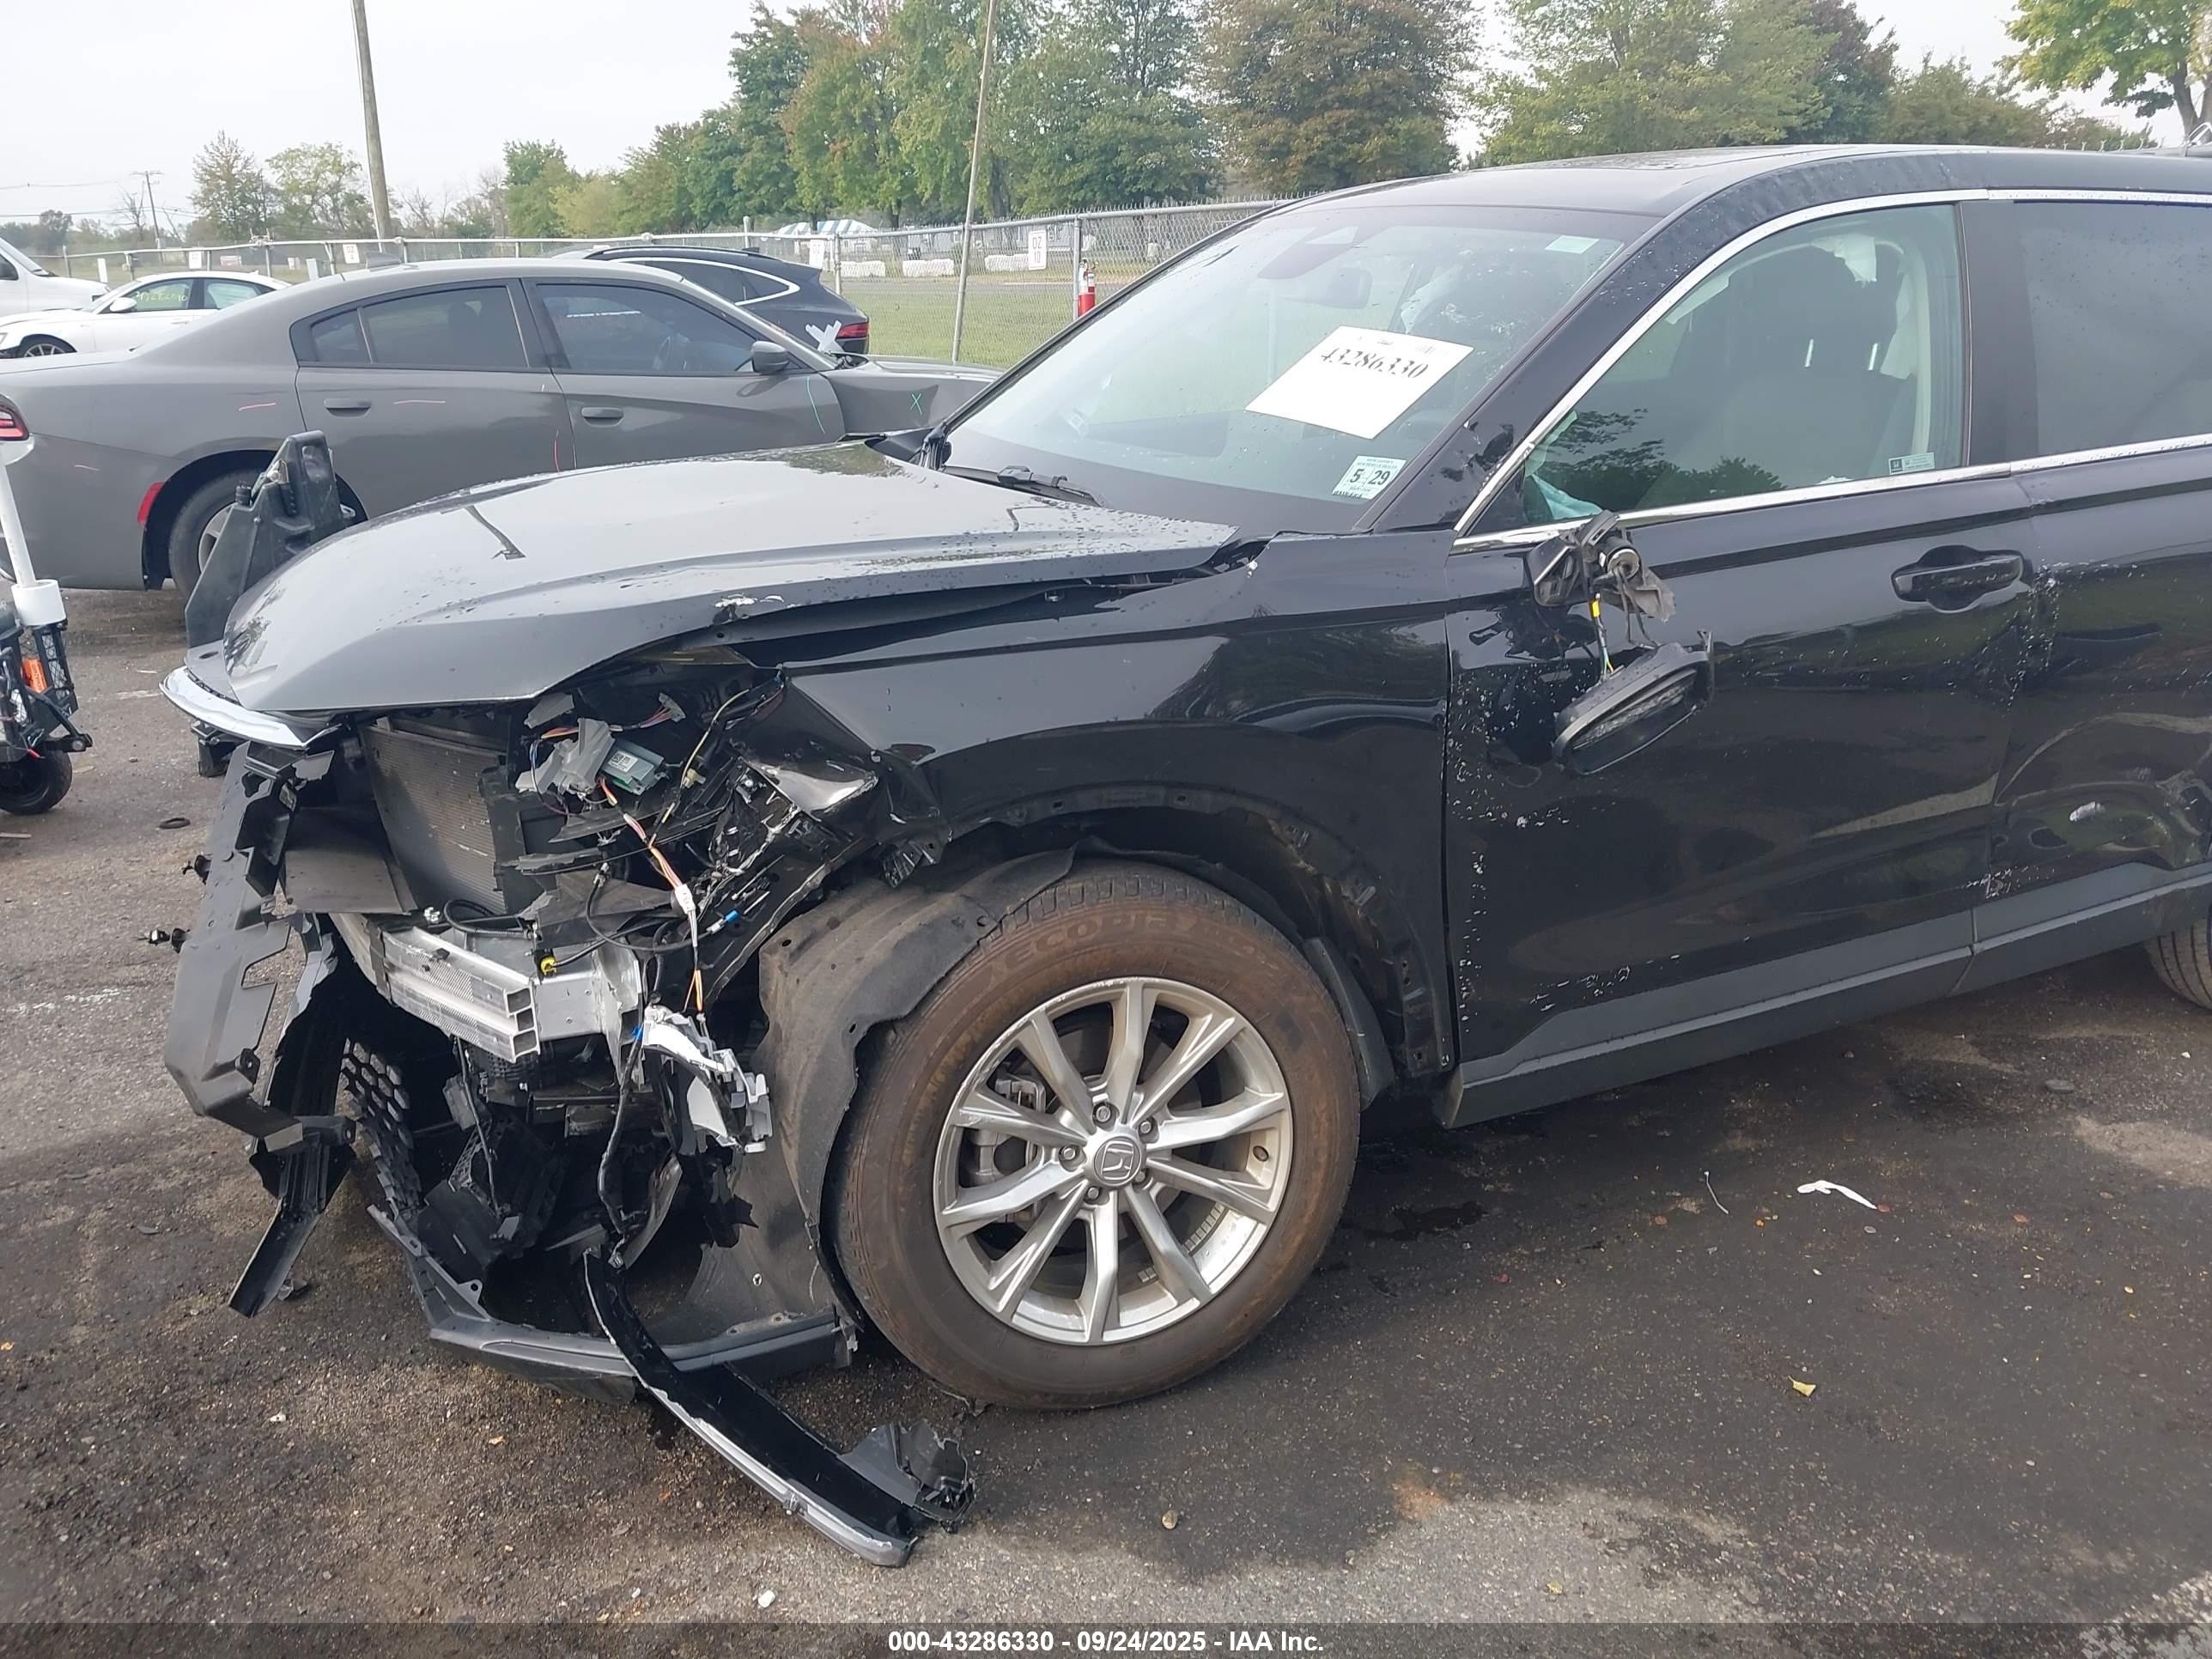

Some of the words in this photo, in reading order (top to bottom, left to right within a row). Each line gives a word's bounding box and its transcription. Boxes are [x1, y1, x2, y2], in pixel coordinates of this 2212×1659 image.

[1321, 347, 1429, 379] 43286330
[1349, 468, 1365, 483] 5
[1367, 470, 1391, 486] 29
